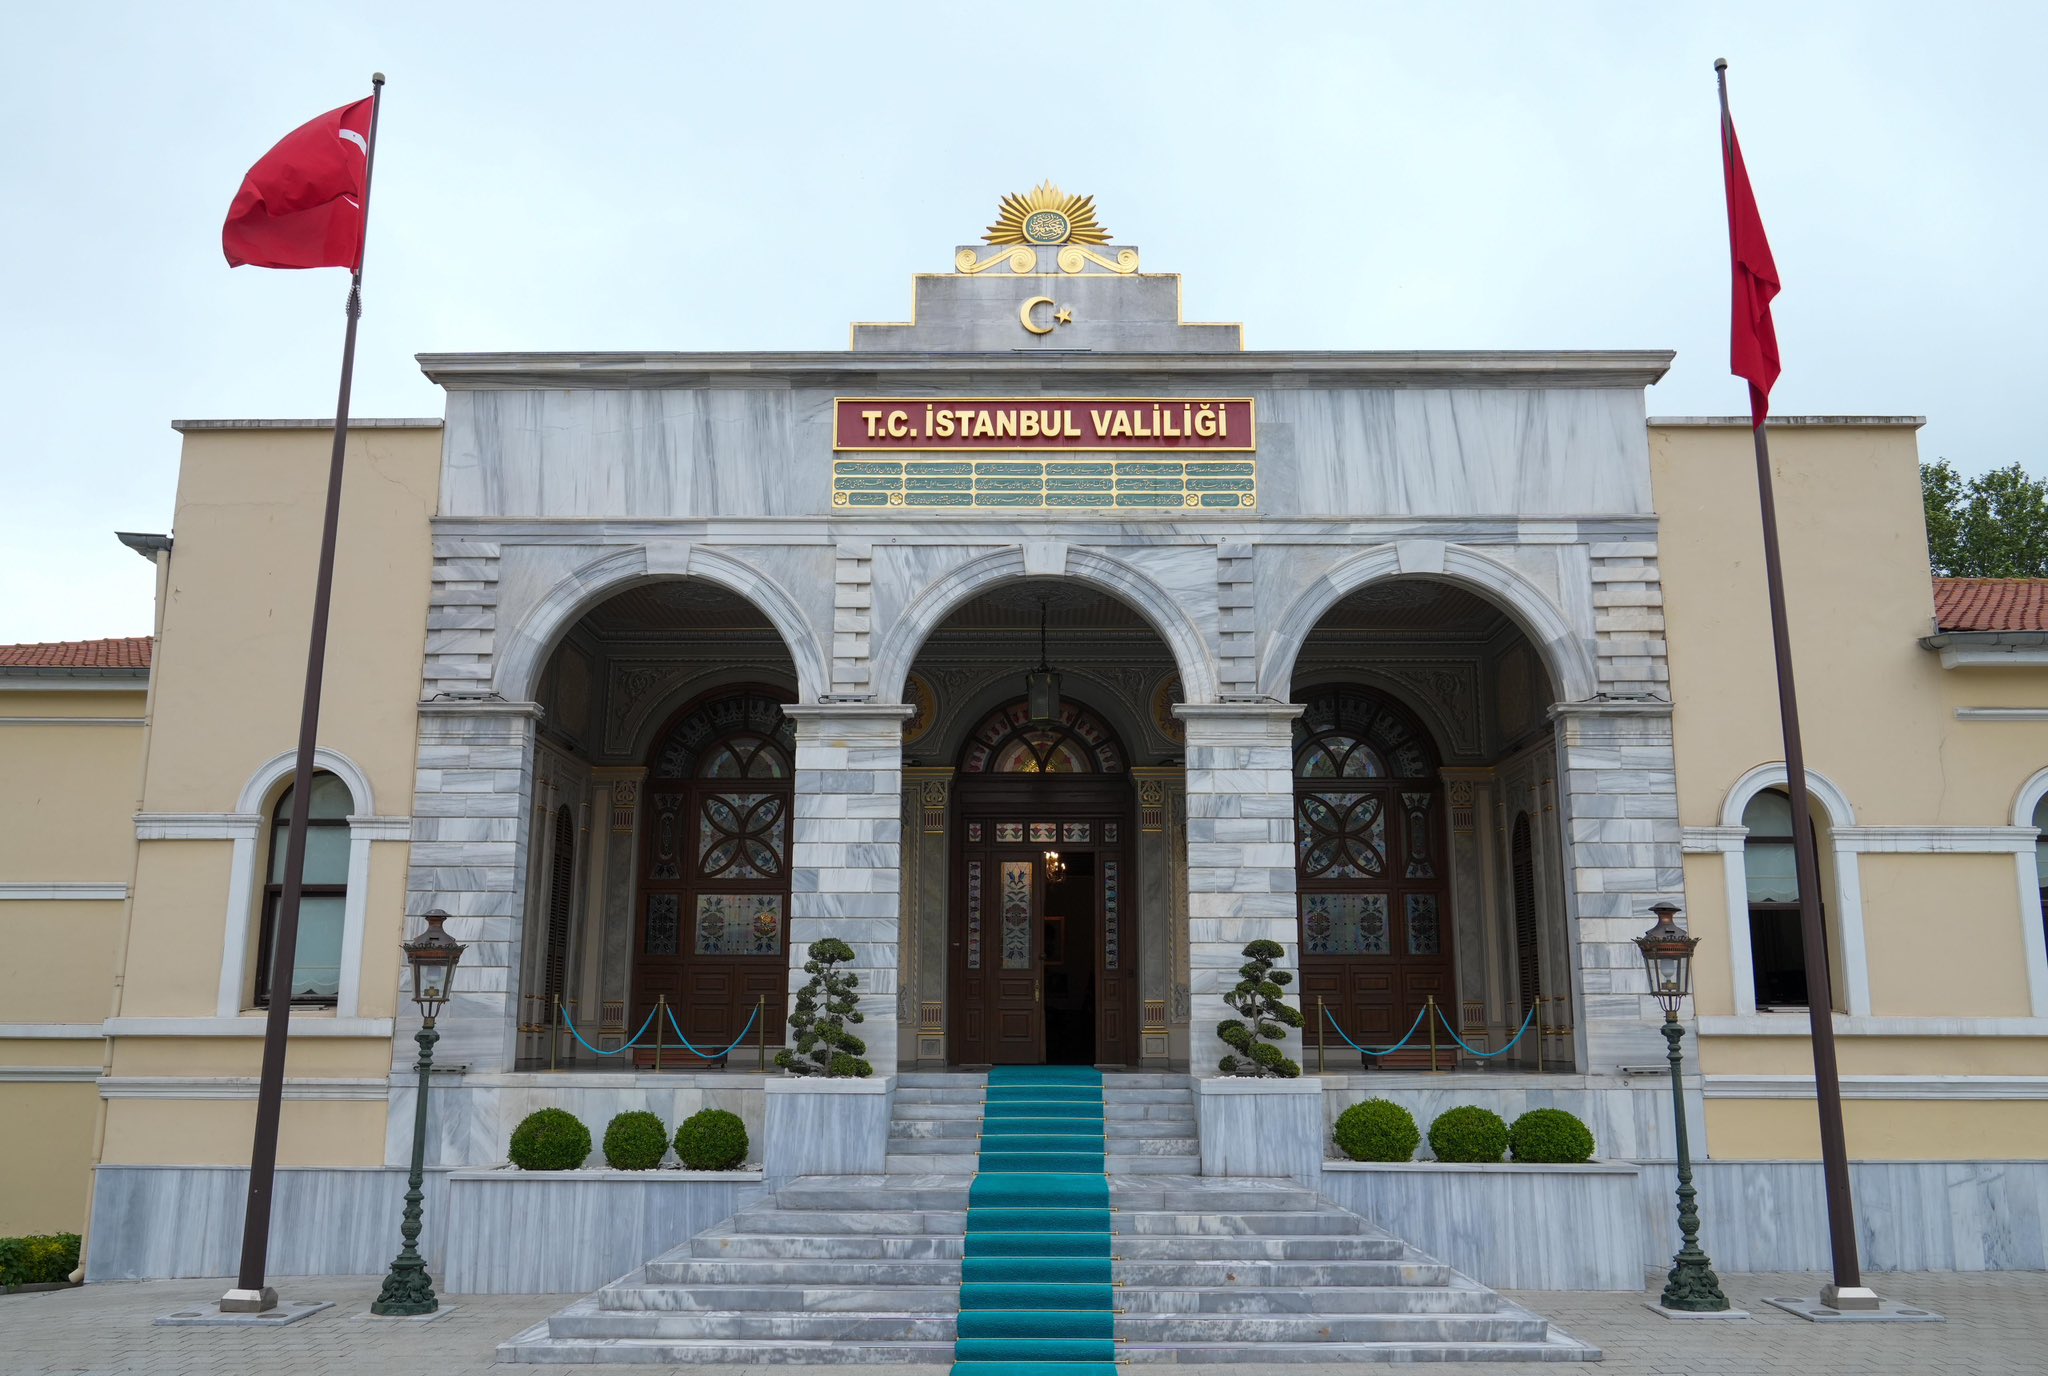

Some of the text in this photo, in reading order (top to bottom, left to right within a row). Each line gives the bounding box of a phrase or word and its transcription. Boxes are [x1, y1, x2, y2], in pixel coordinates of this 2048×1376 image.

[862, 403, 1227, 437] T.C. İSTANBUL VALİLİĞİ
